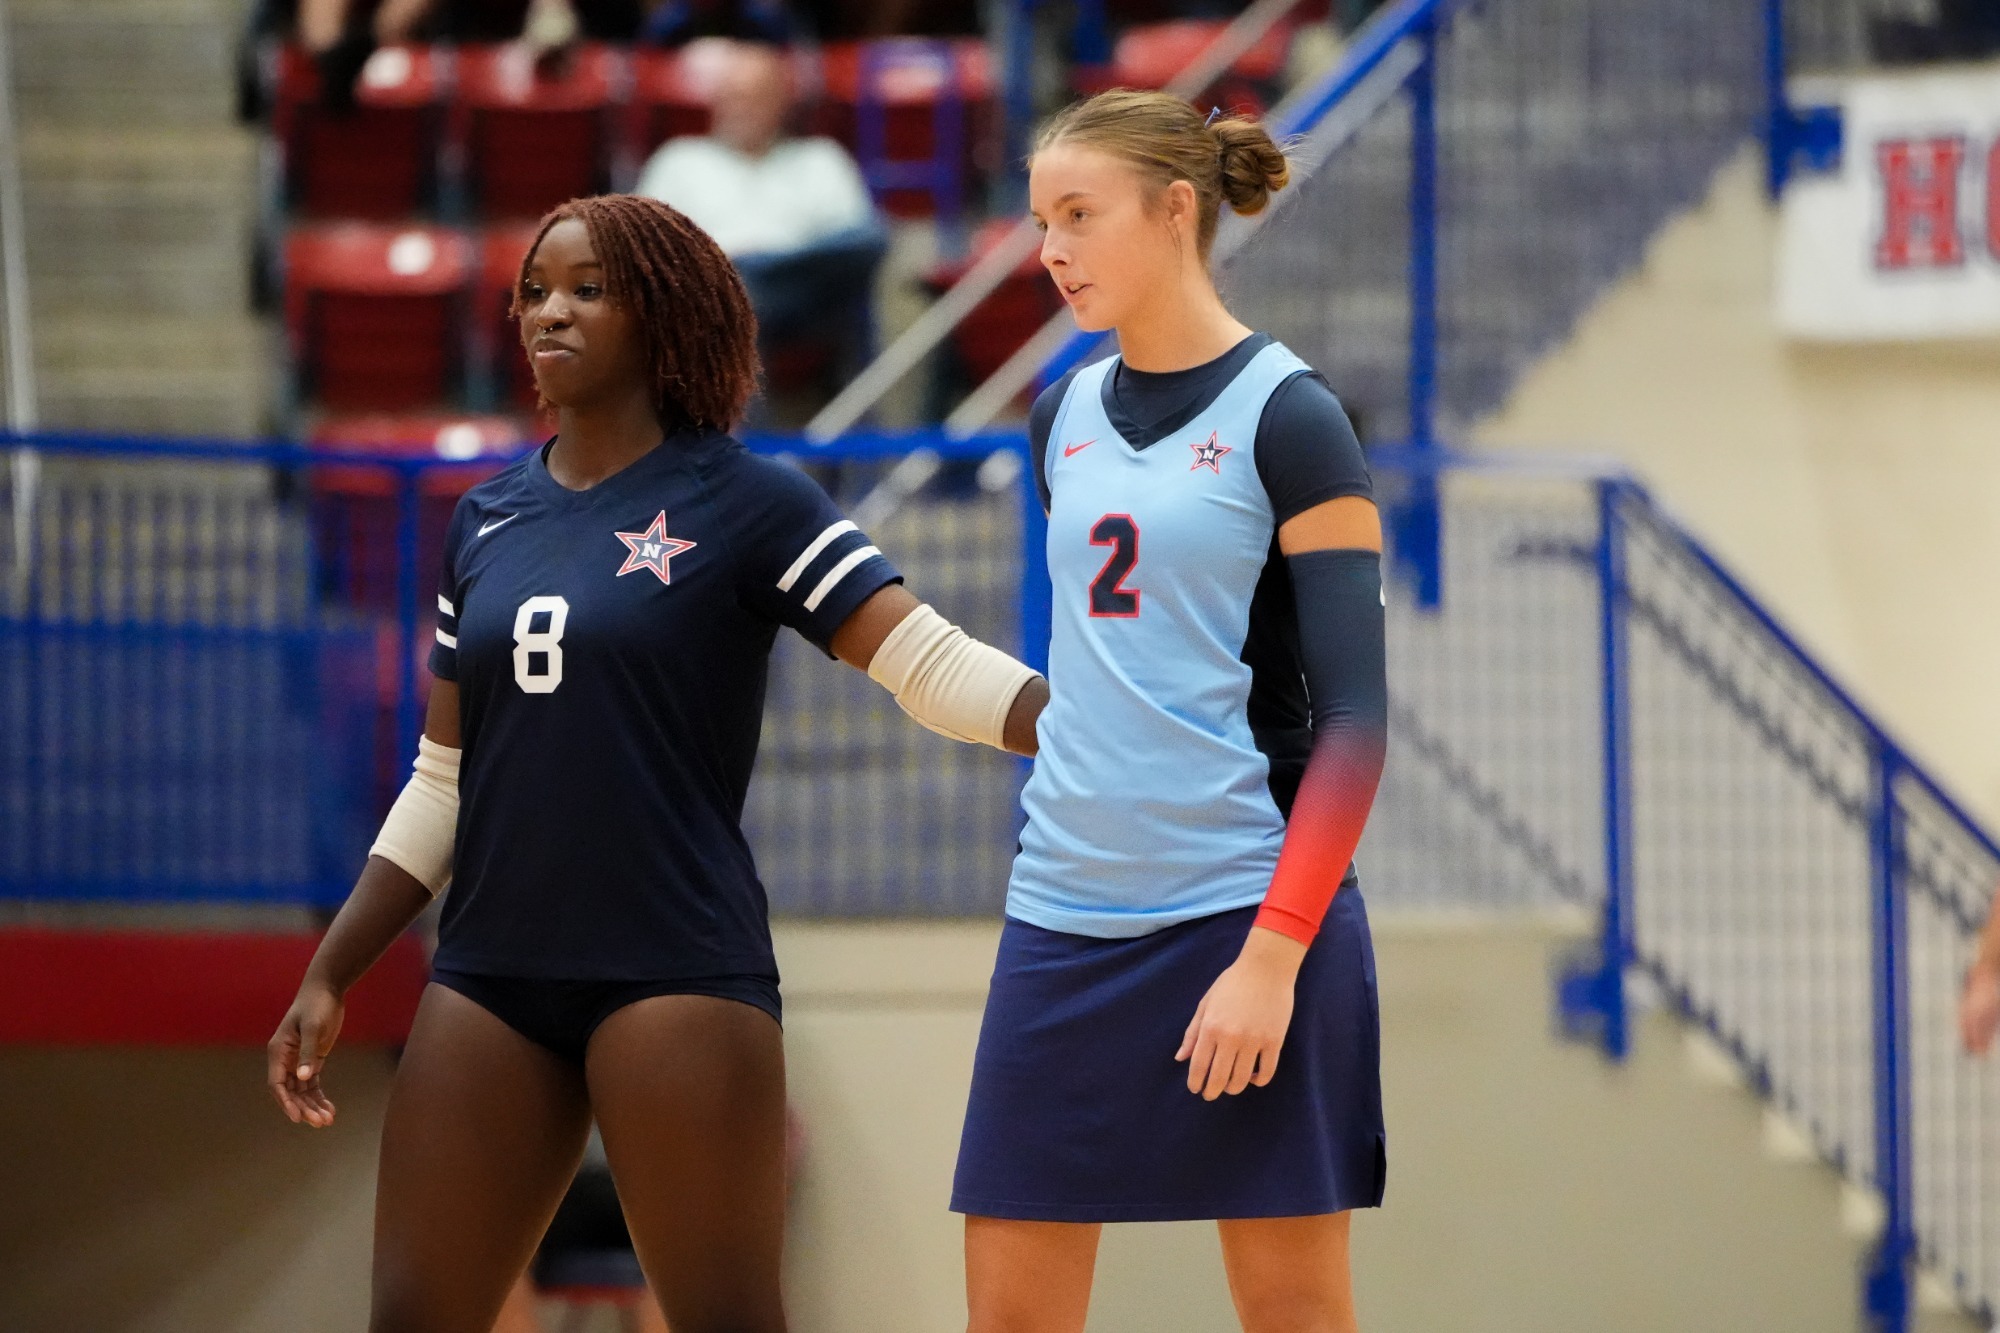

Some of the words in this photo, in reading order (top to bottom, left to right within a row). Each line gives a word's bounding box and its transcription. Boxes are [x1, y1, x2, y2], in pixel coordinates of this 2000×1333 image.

[1203, 449, 1215, 460] N
[641, 542, 662, 559] N
[1089, 513, 1140, 618] 2
[513, 596, 569, 693] 8
